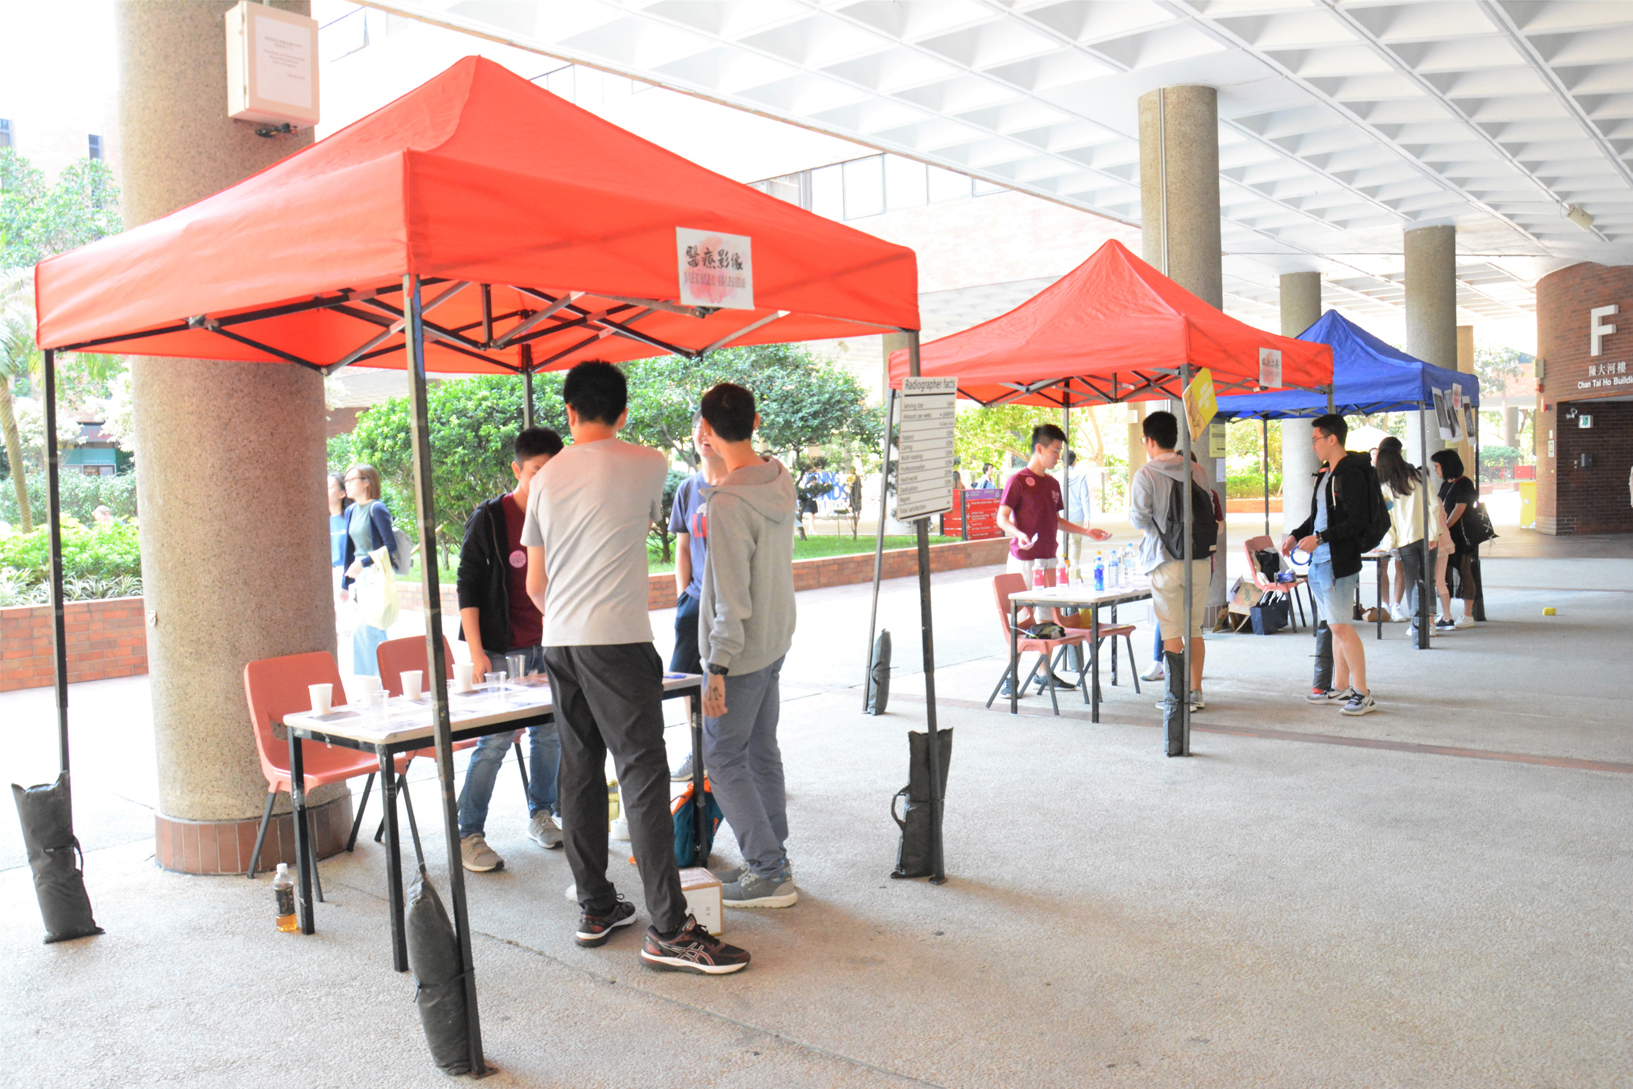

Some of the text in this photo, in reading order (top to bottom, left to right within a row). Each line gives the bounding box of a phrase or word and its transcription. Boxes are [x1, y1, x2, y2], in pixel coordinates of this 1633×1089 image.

[686, 245, 743, 270] 醫療影像
[1591, 304, 1619, 356] F
[1588, 361, 1626, 377] 陳大河樓
[905, 377, 956, 392] Radiographer facts
[1577, 381, 1591, 389] Chan
[1592, 379, 1602, 388] Tai
[1602, 378, 1612, 387] Ho
